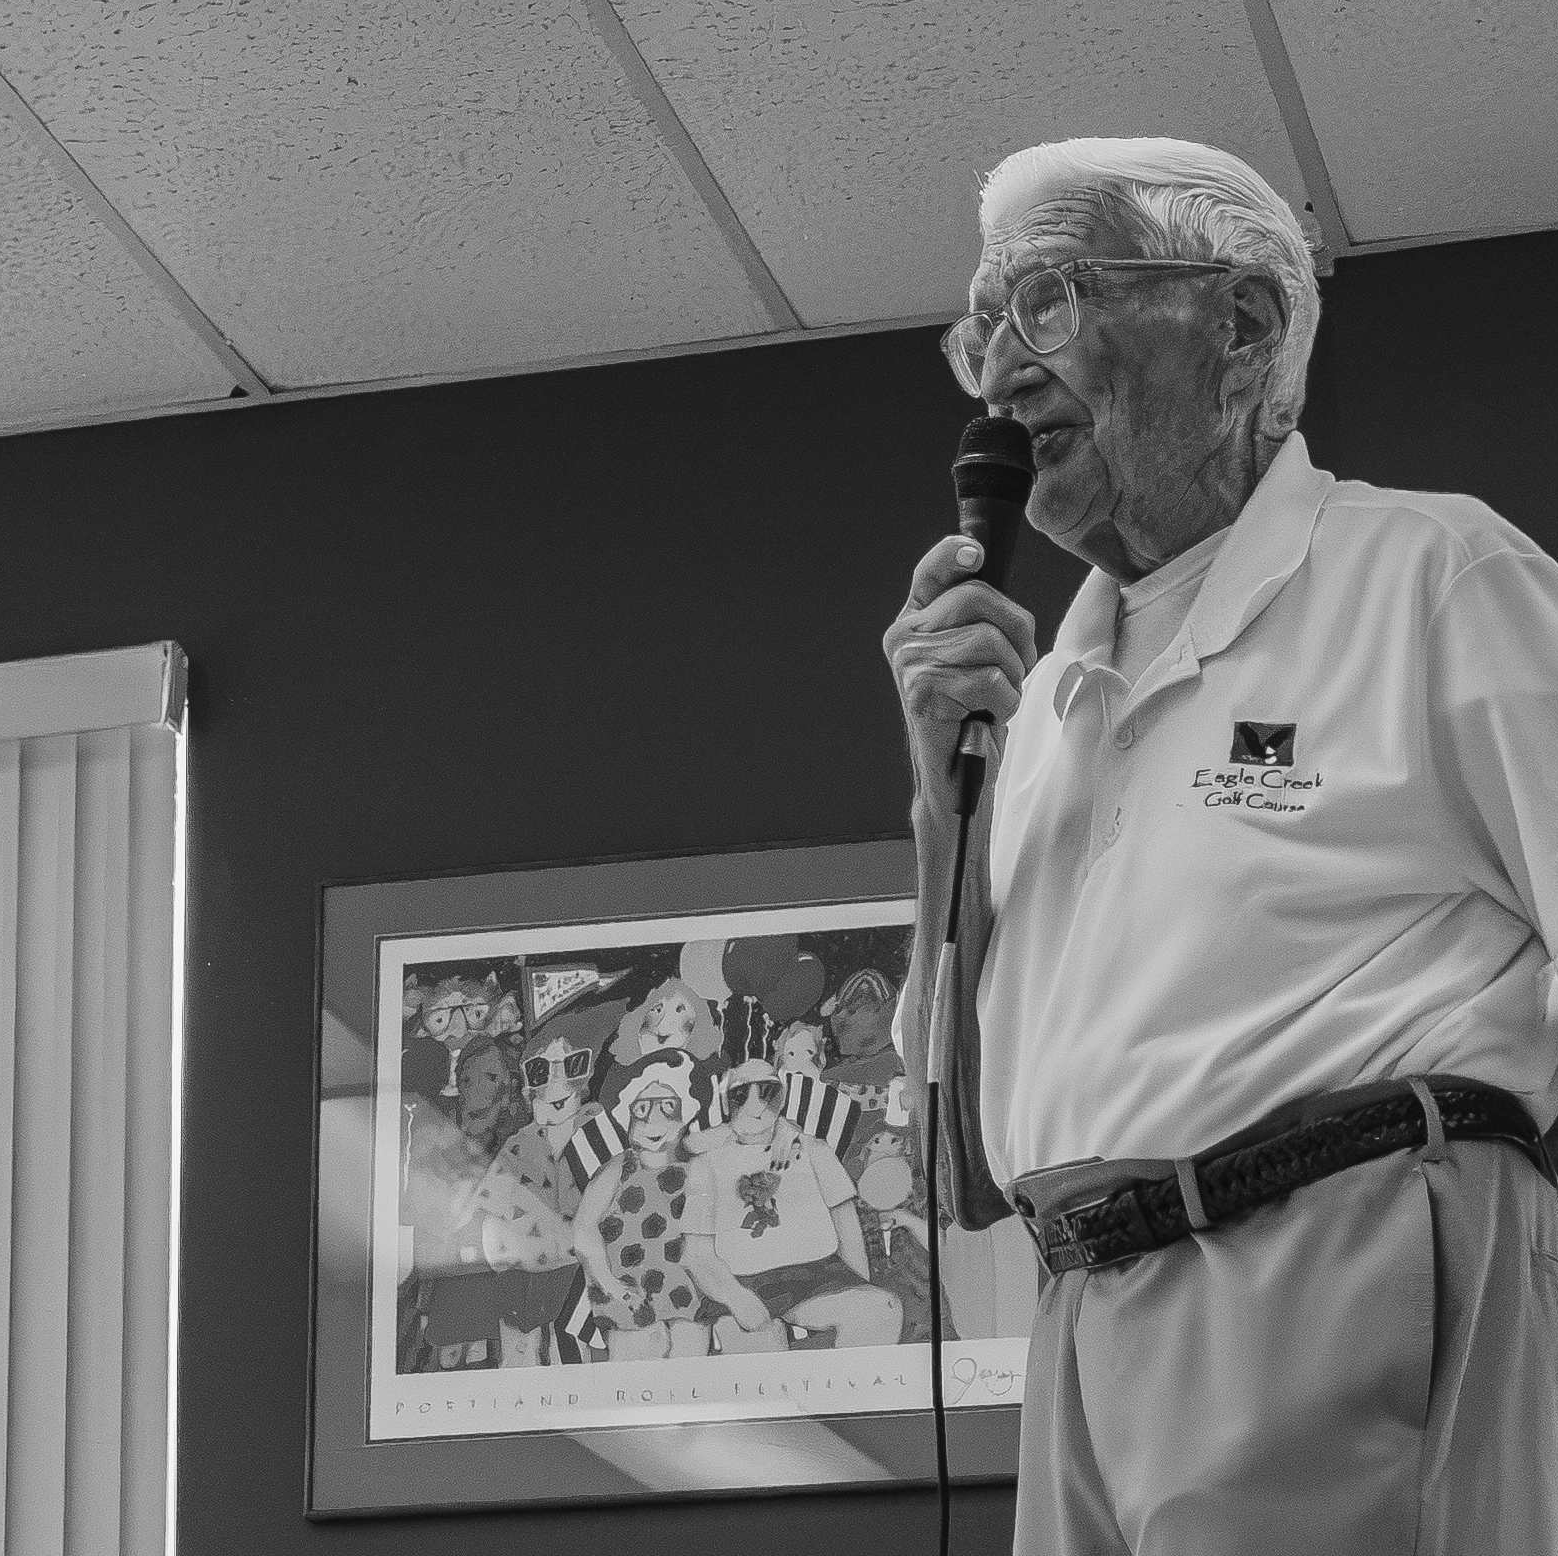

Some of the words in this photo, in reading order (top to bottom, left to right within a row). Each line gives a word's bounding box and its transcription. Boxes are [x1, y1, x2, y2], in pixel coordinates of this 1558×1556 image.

[1191, 767, 1255, 789] Eagle
[1261, 769, 1324, 790] Creek
[1204, 790, 1243, 807] Golf
[1246, 792, 1305, 812] Course
